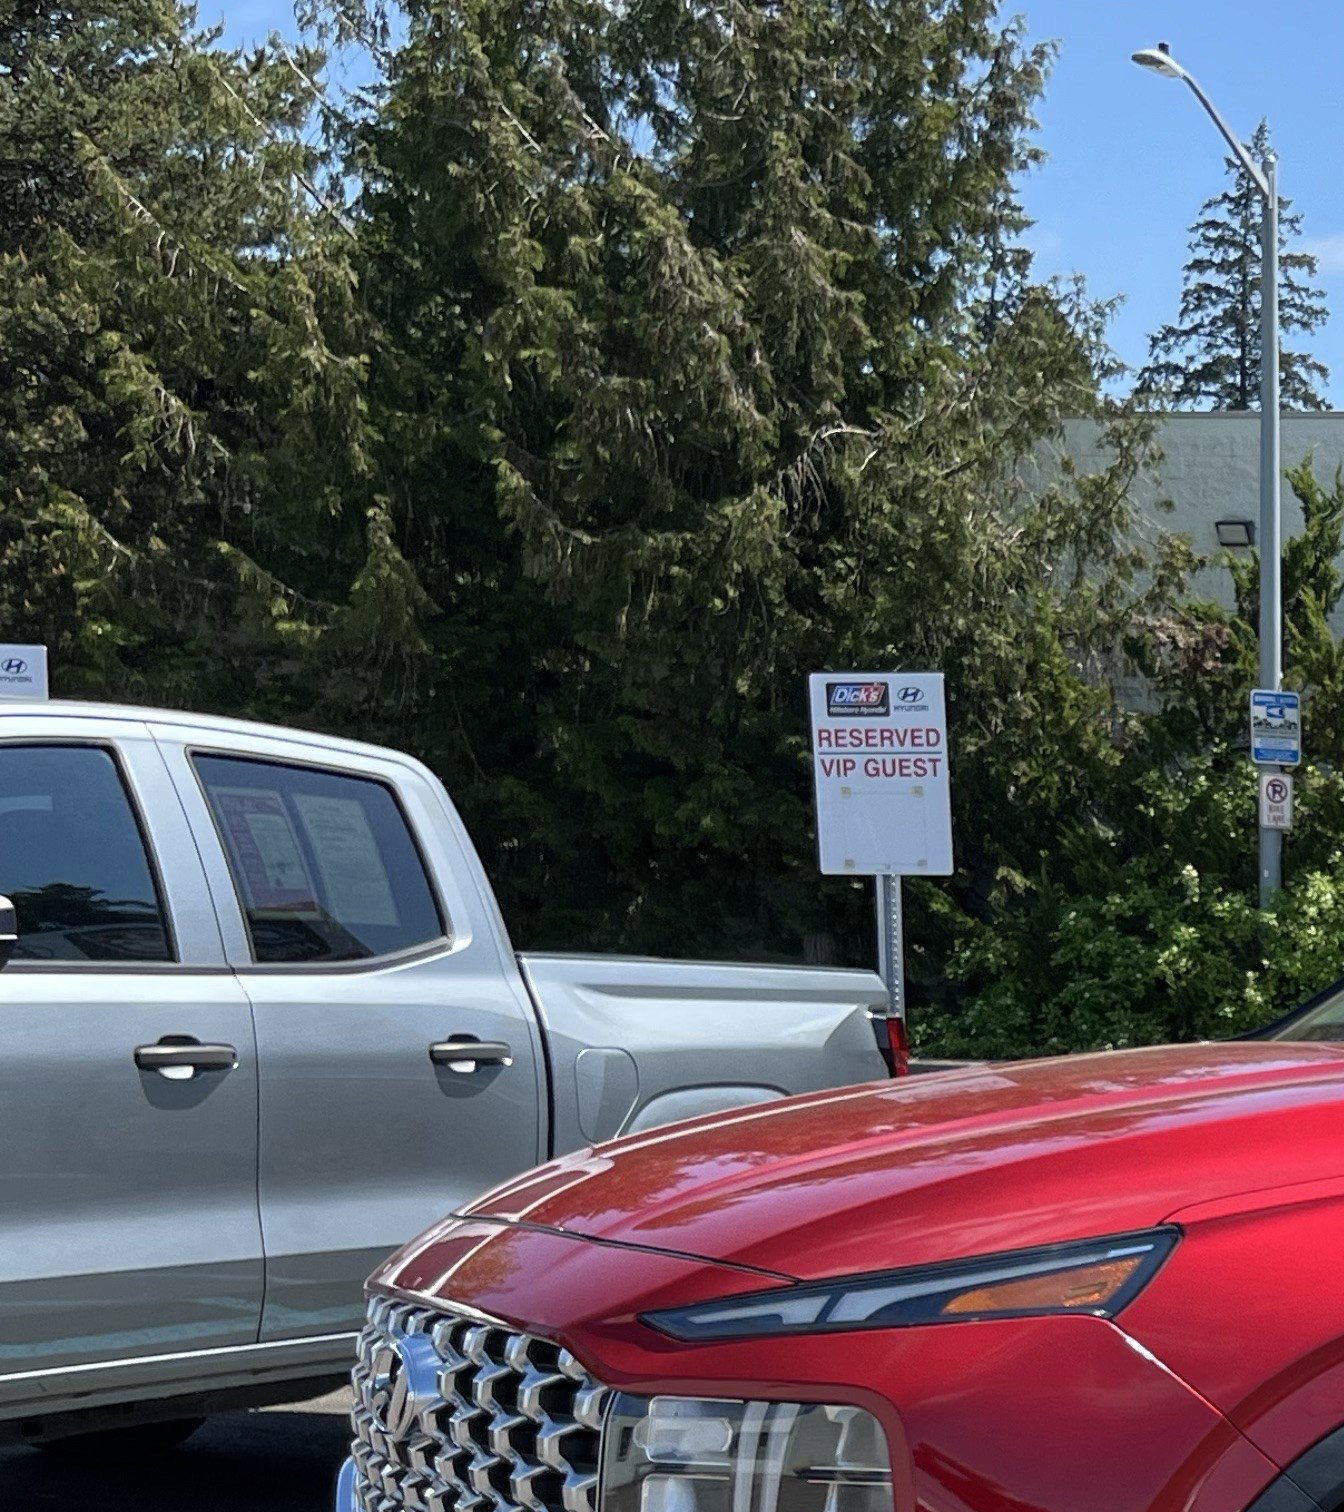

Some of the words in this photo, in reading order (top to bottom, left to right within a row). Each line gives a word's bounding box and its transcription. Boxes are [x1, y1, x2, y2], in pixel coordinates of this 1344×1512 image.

[834, 685, 879, 703] Dick's
[818, 728, 941, 748] RESERVED
[820, 758, 857, 778] VIP
[863, 758, 942, 778] GUEST
